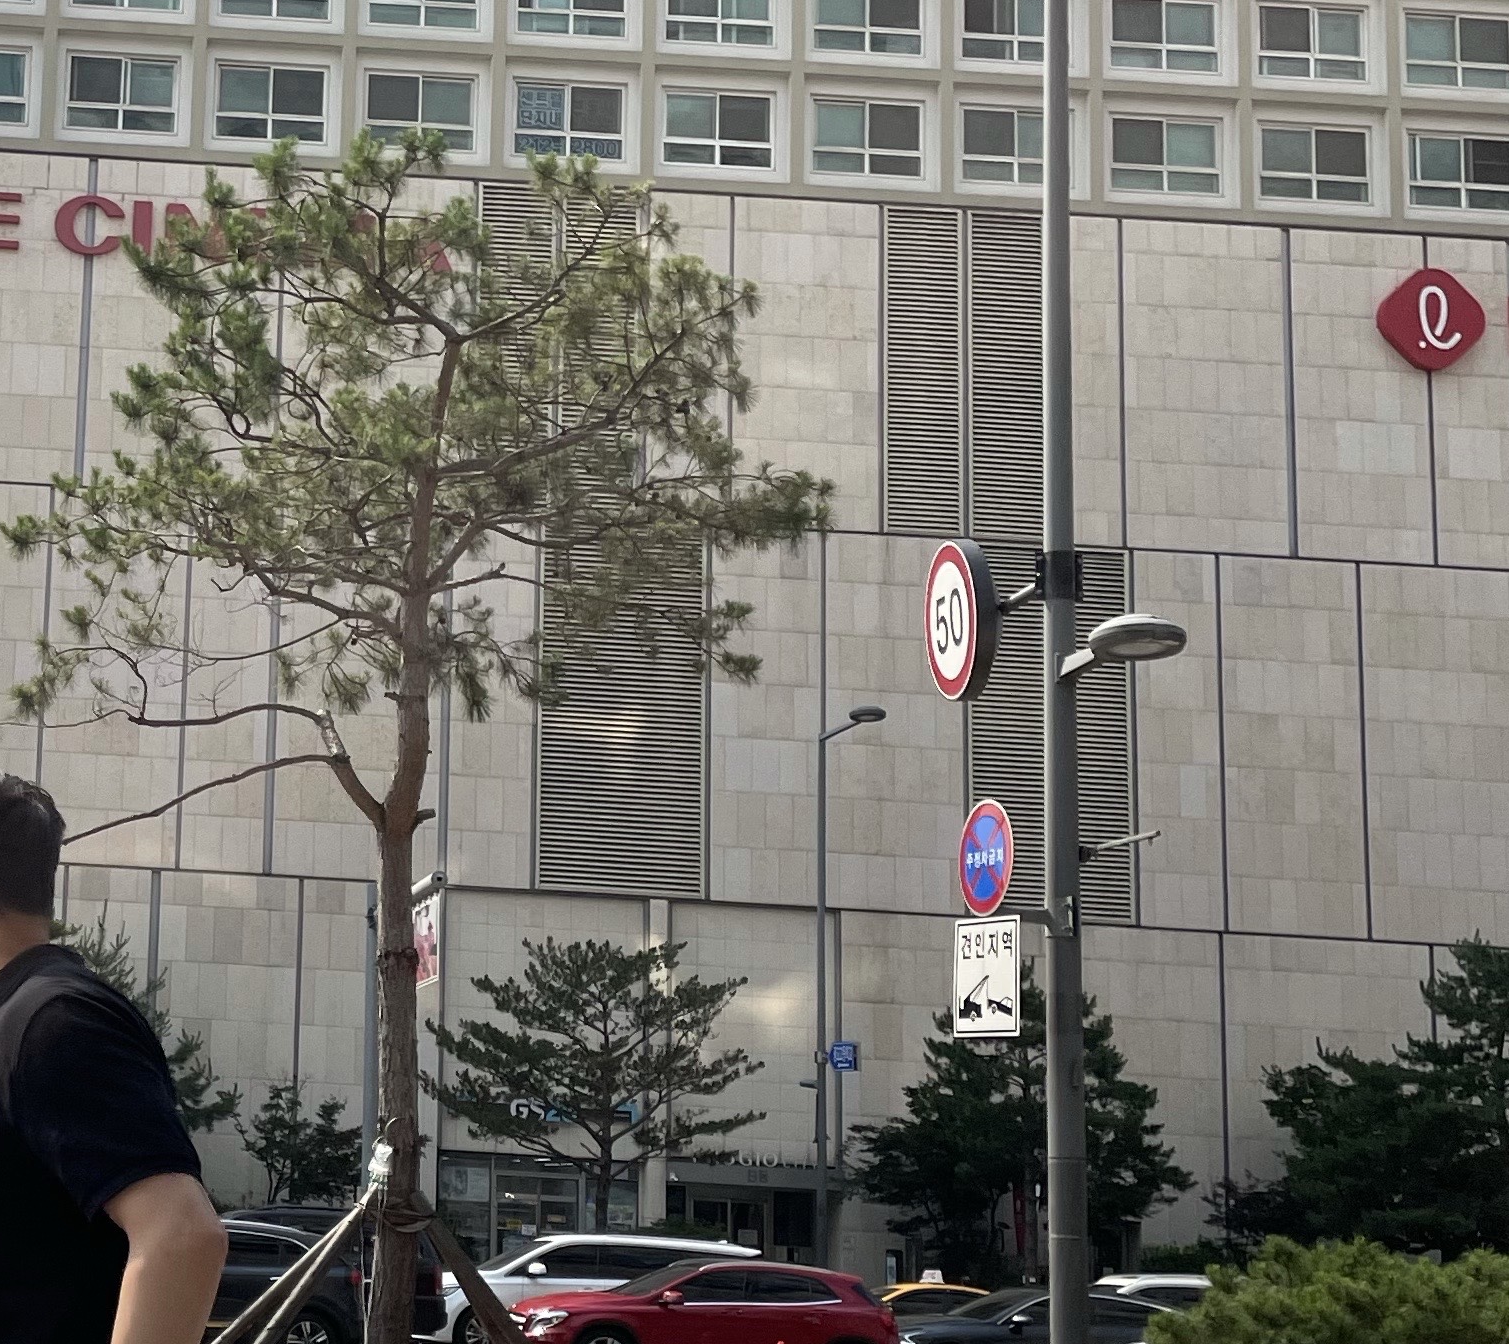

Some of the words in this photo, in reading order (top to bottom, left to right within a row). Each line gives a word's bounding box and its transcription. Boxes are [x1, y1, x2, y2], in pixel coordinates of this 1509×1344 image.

[935, 587, 964, 655] 50
[966, 847, 1004, 869] 주정차금지
[961, 928, 1013, 960] 견인지역
